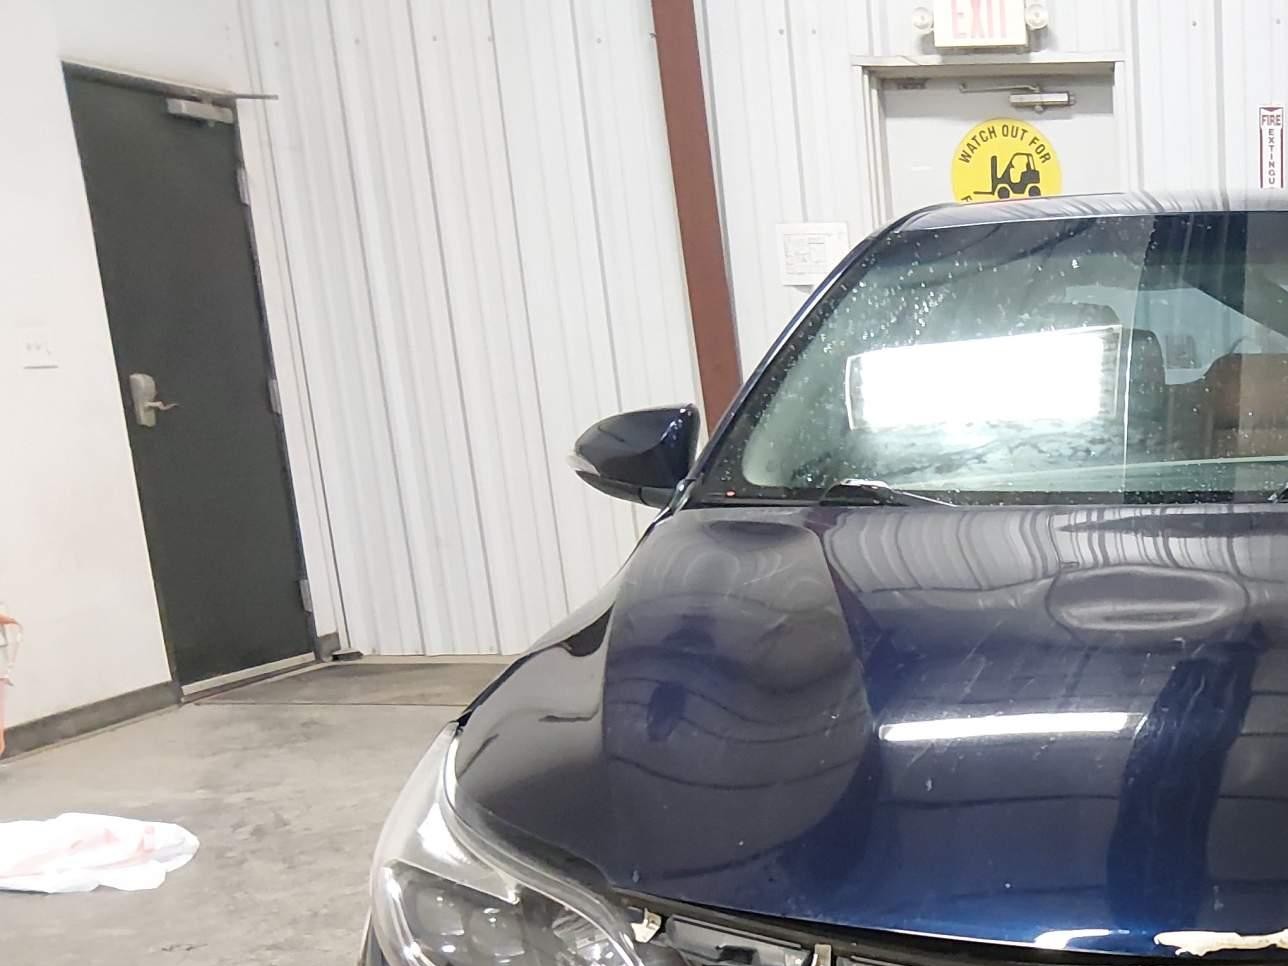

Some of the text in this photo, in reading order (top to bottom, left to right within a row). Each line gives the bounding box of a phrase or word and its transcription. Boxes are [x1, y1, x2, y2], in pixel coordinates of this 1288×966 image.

[1261, 114, 1281, 126] FIRE
[959, 124, 1052, 164] WATCH OUT FOR
